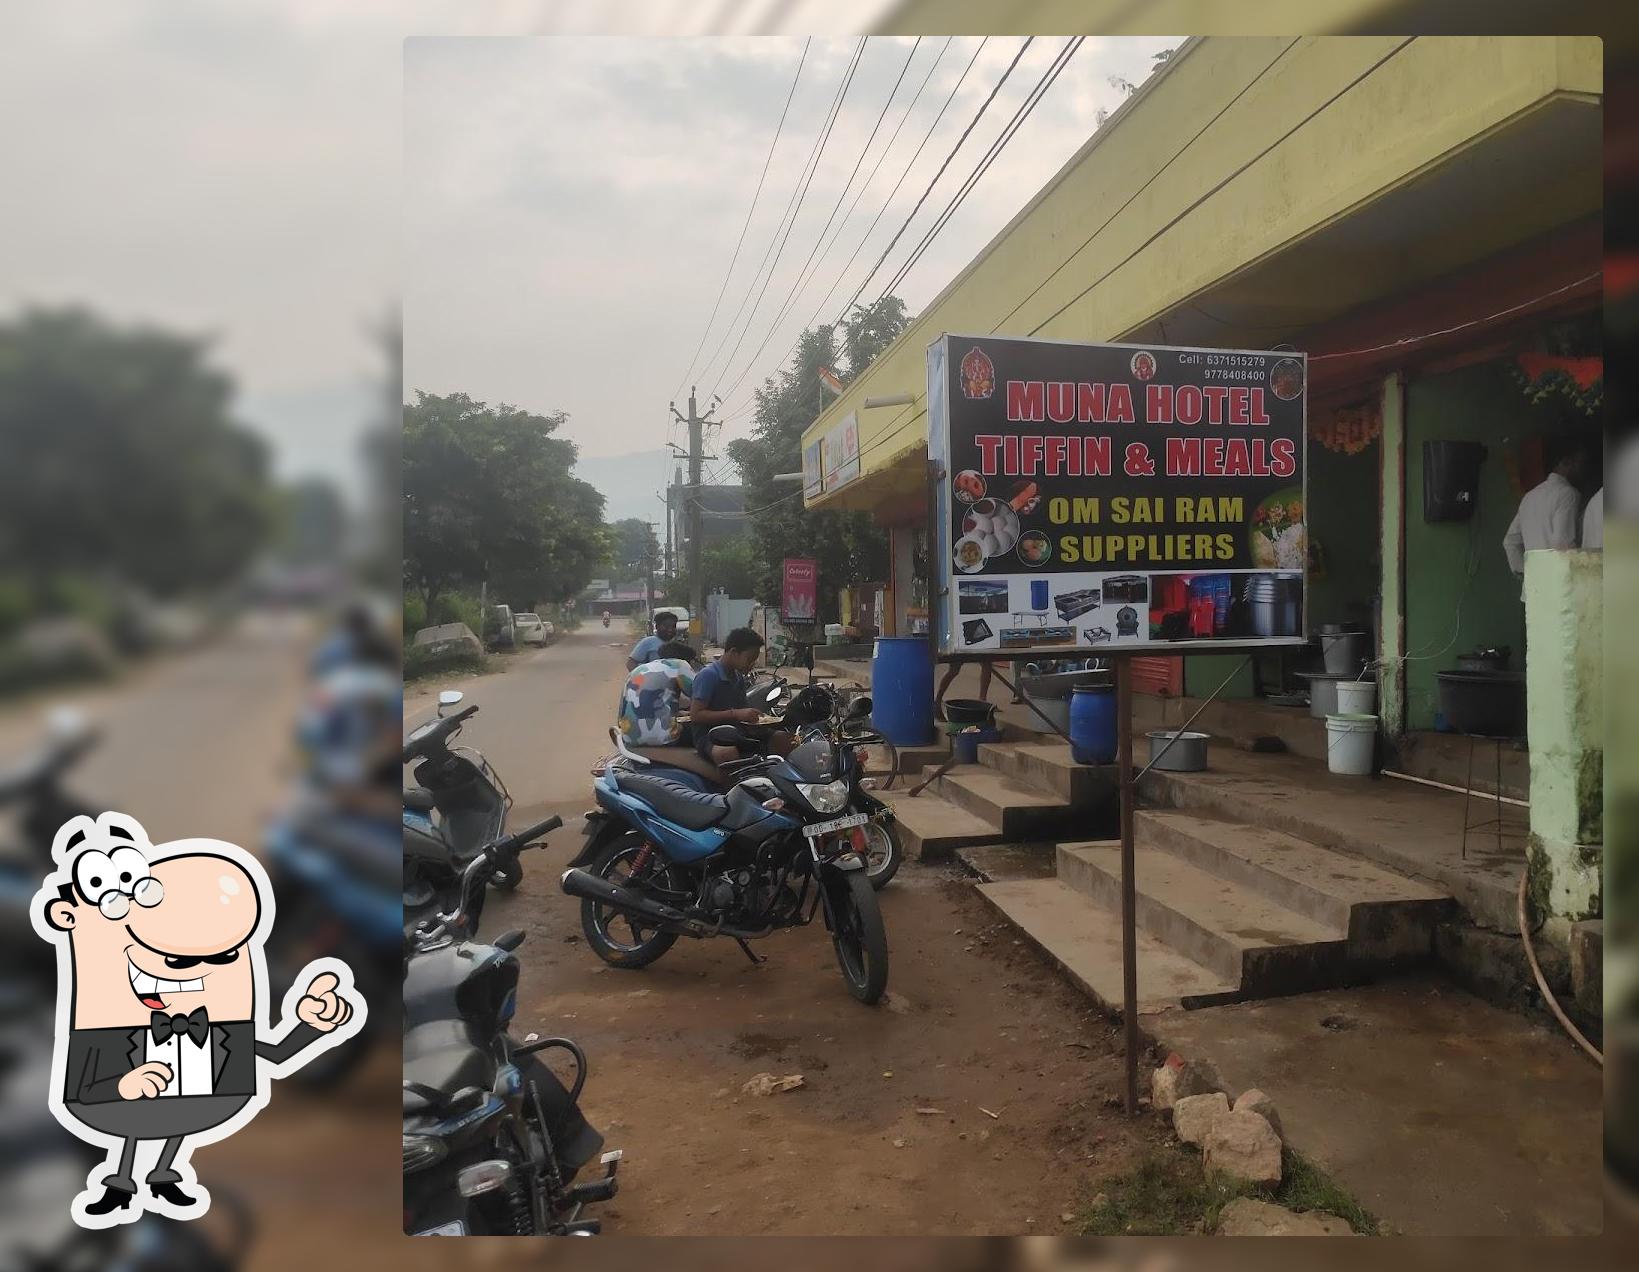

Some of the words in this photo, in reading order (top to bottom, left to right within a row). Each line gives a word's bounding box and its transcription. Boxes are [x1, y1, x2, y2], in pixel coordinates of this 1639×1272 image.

[1179, 354, 1202, 365] Cell:
[1206, 355, 1265, 366] 6371515279
[1204, 369, 1265, 381] 9778408400
[1007, 381, 1135, 423] MUNA
[1146, 385, 1270, 426] HOTEL
[975, 435, 1112, 476] TIFFIN
[1124, 442, 1155, 477] &
[1166, 438, 1296, 477] MEALS
[1049, 497, 1099, 524] OM
[1111, 497, 1164, 524] SAI
[1176, 497, 1244, 523] RAM
[1060, 534, 1235, 563] SUPPLIERS
